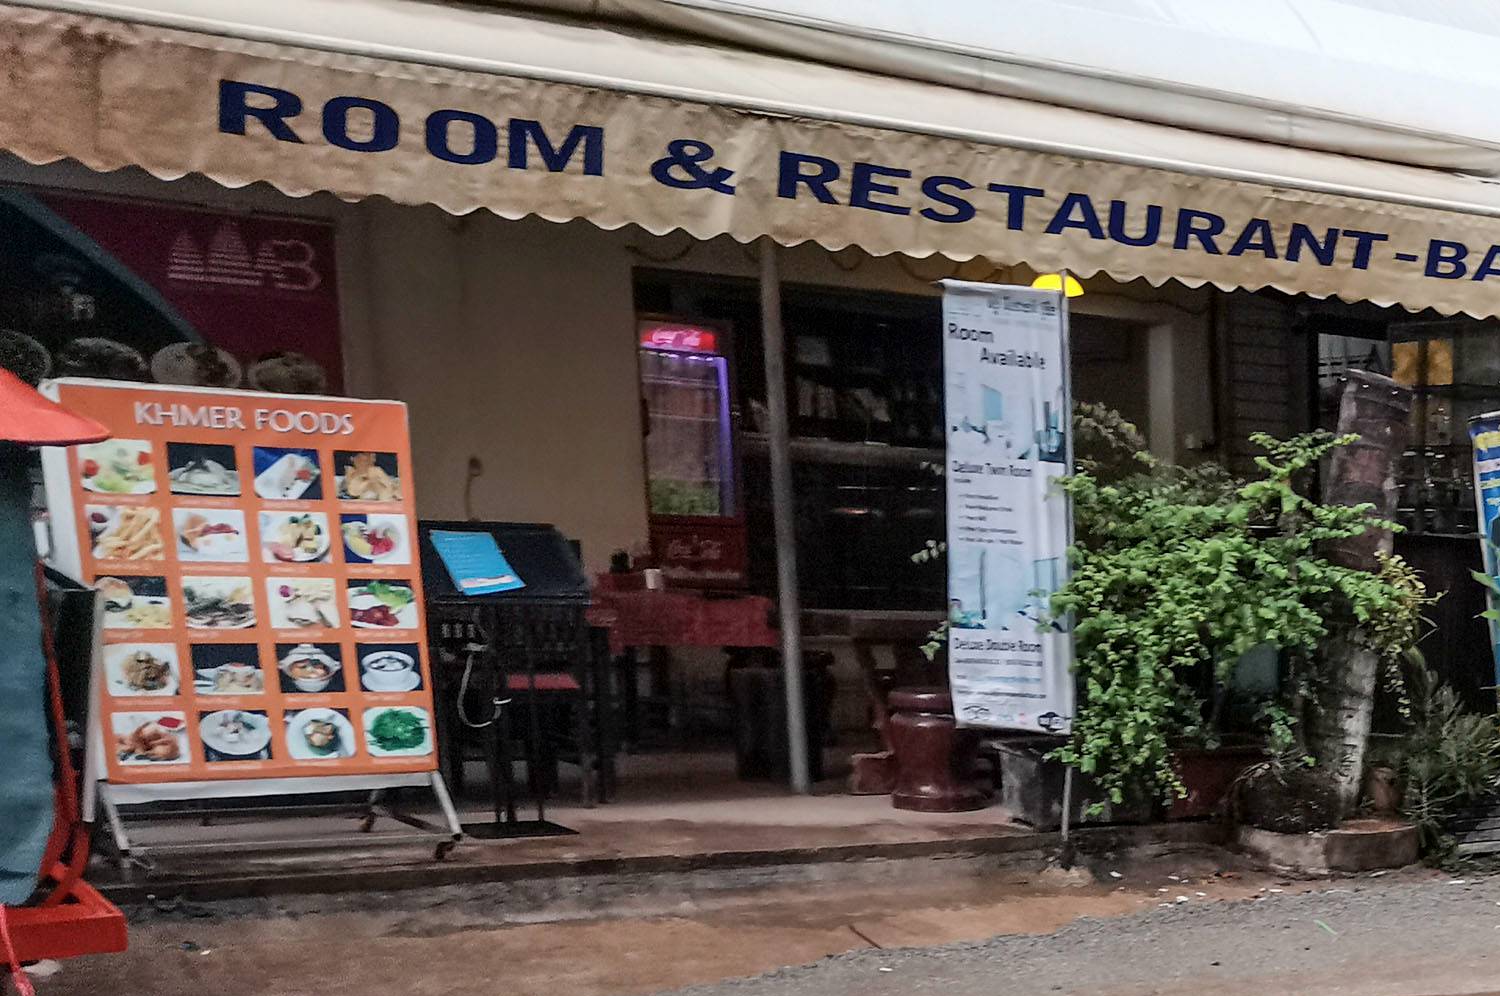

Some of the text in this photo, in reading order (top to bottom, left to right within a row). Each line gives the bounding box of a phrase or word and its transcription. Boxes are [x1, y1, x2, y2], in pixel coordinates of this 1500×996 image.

[219, 79, 604, 176] ROOM
[651, 139, 736, 195] &
[948, 322, 994, 343] Room
[980, 346, 1046, 370] Available
[133, 401, 355, 435] KHMER FOODS
